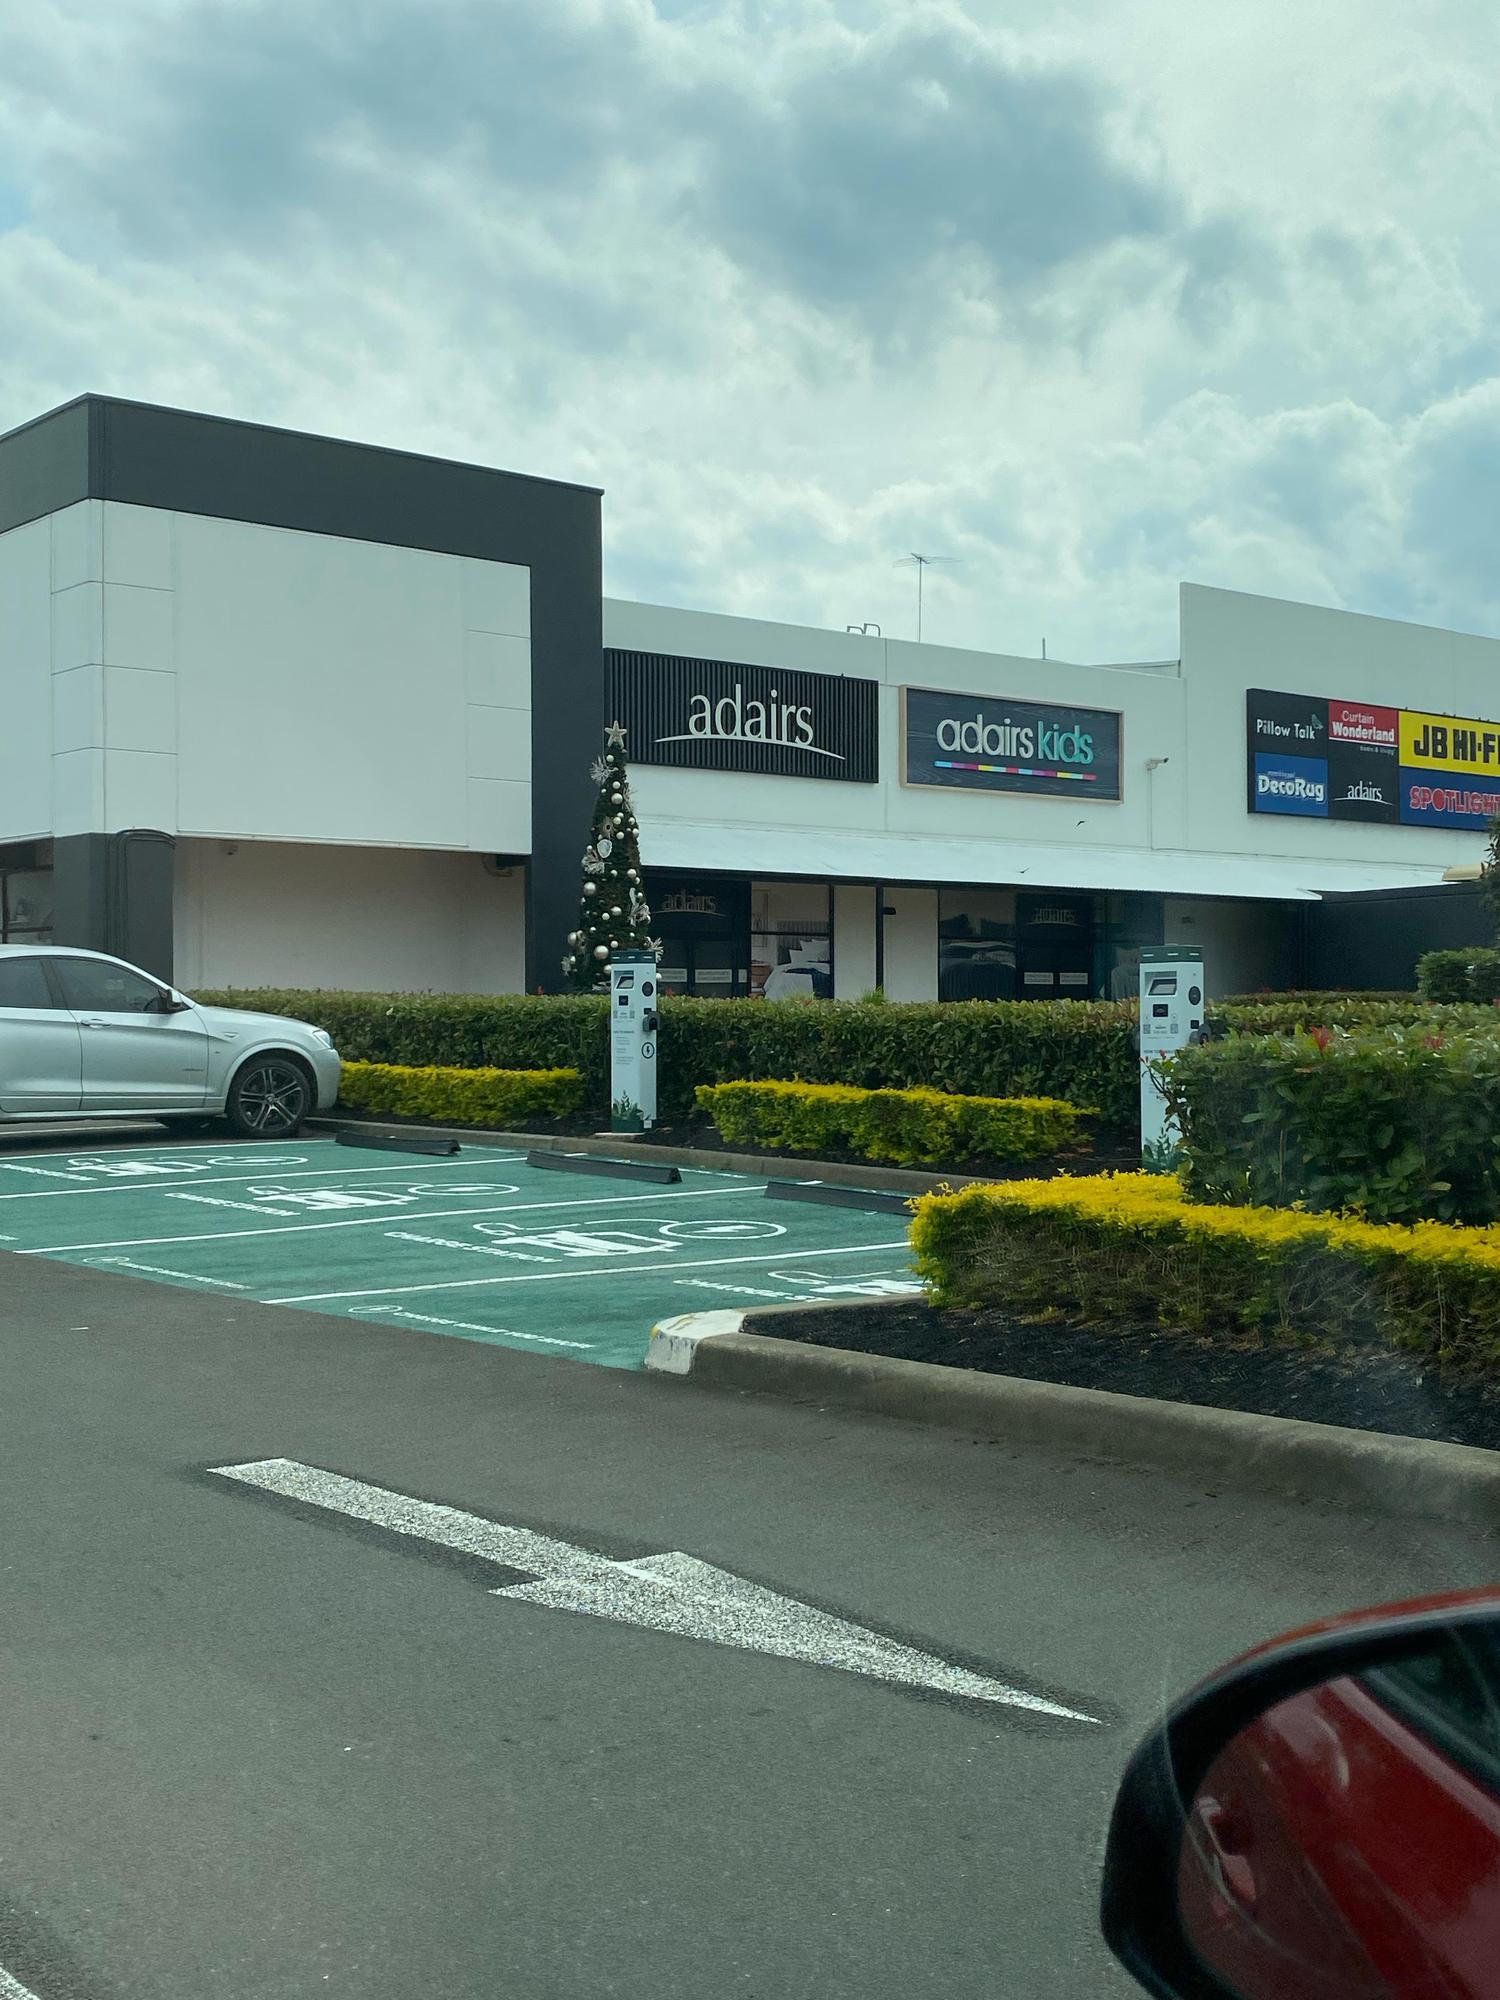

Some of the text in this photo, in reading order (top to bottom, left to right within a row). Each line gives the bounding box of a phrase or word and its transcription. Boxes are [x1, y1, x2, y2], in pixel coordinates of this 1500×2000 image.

[688, 683, 814, 746] adairs
[1342, 710, 1375, 724] Curtain
[936, 714, 1094, 765] adairs kids
[1256, 718, 1315, 740] Pillow Talk
[1332, 721, 1395, 742] Wonderland
[1413, 724, 1448, 759] JB
[1257, 775, 1325, 803] DecoRug
[1347, 780, 1383, 801] adairs
[662, 887, 717, 912] adairs
[384, 1231, 563, 1263] CHARGE STATION
[673, 1279, 794, 1298] CHARGE
